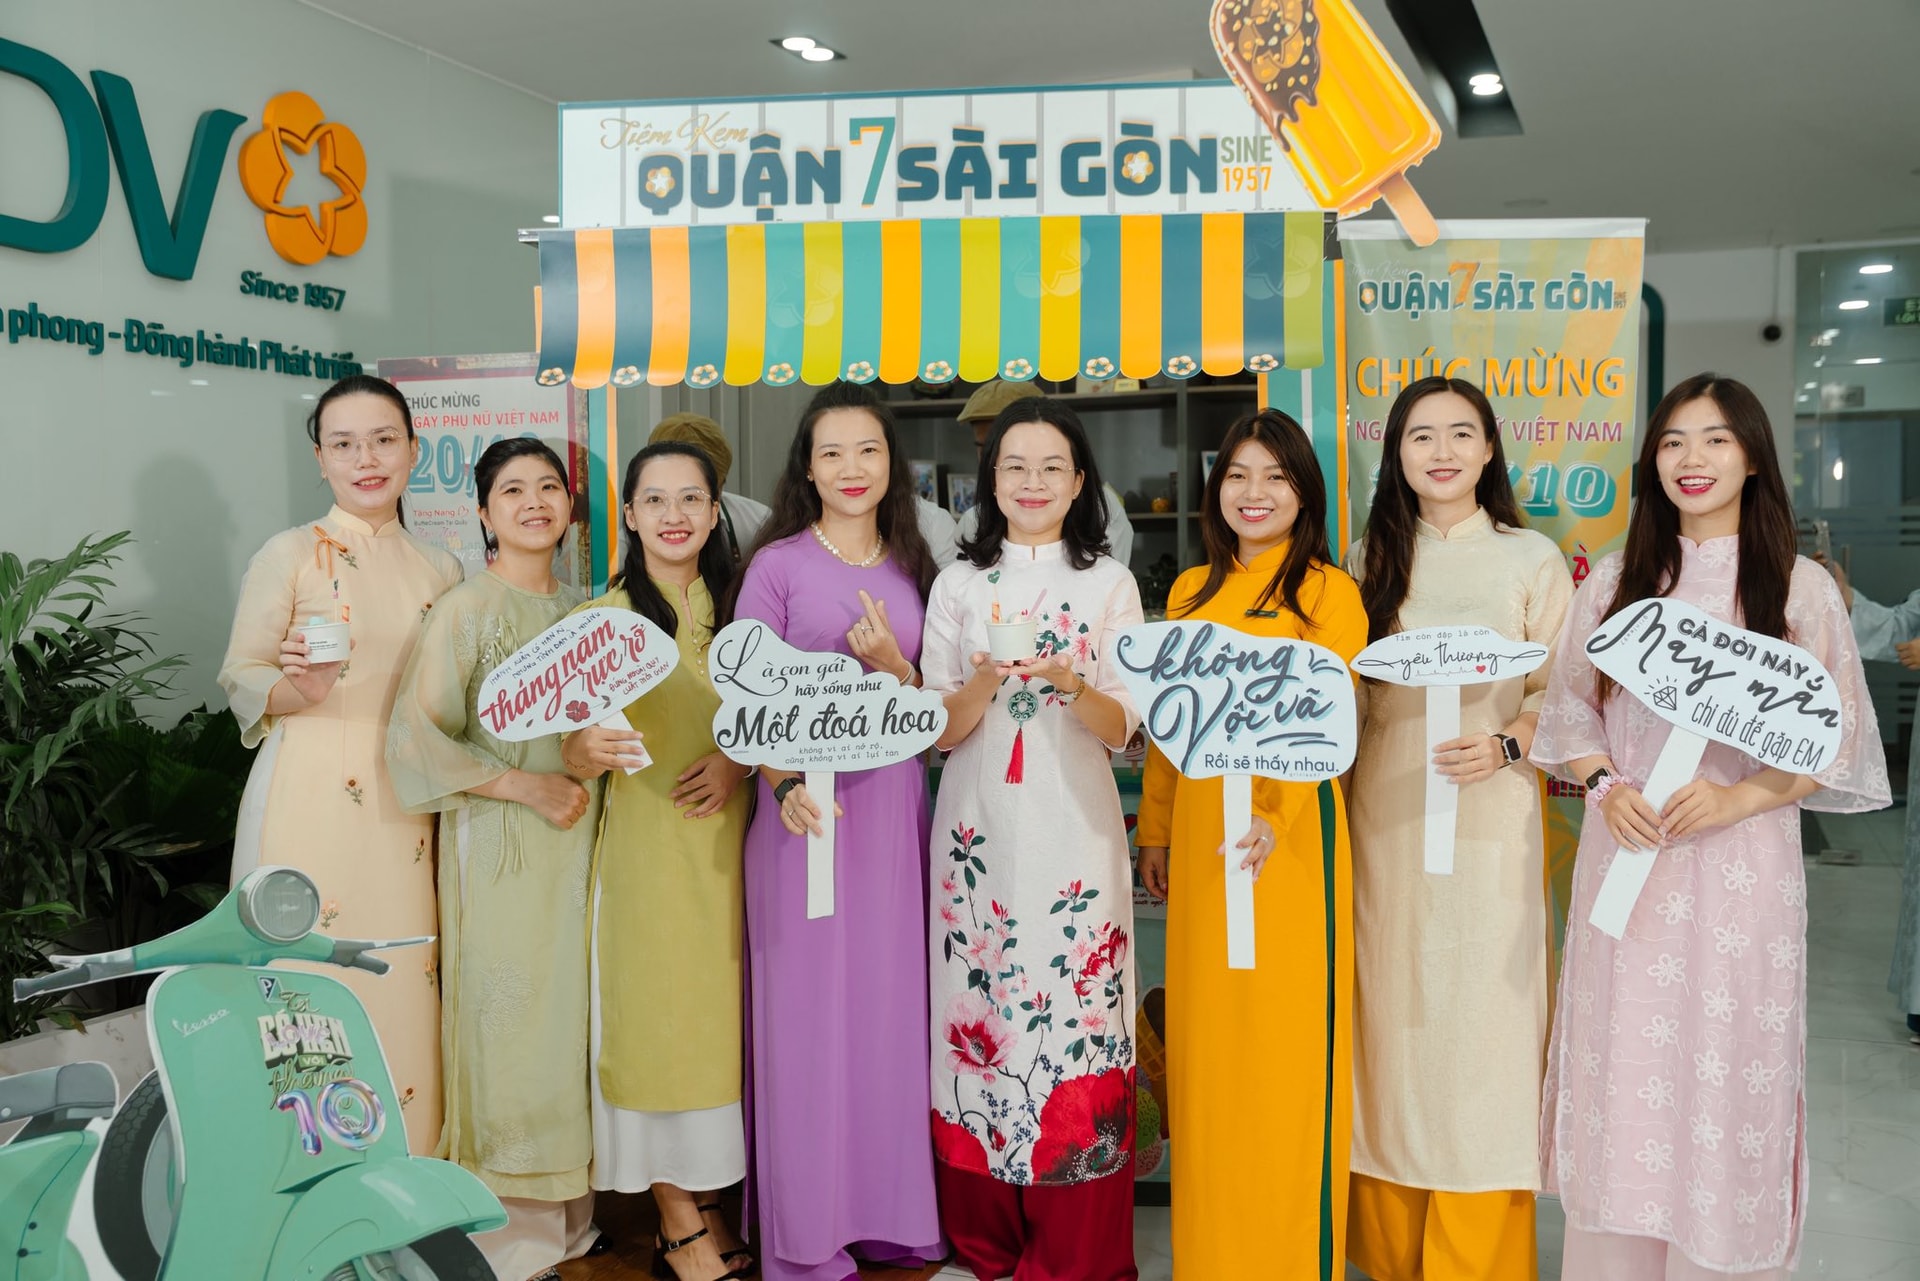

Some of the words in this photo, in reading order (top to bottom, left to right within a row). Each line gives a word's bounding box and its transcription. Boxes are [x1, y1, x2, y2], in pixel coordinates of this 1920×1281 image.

[677, 111, 749, 151] Kem
[1221, 136, 1272, 163] SINE
[639, 132, 842, 221] QUẬN
[849, 116, 896, 209] 7
[897, 124, 1037, 202] SÀI
[1060, 120, 1217, 197] GÒN
[1222, 166, 1272, 193] 1957
[240, 270, 299, 304] Since
[303, 282, 346, 312] 1957
[1359, 271, 1449, 320] QUẬN
[1448, 262, 1480, 309] 7
[1472, 271, 1535, 310] SÀI
[1544, 271, 1613, 310] GÒN
[9, 303, 104, 355] phong
[197, 329, 256, 369] hành
[260, 340, 312, 377] Phát
[1485, 347, 1625, 397] MỪNG
[406, 393, 438, 409] CHÚC
[442, 391, 480, 409] MỪNG
[412, 413, 437, 428] GÀY
[443, 415, 468, 430] PHỤ
[473, 411, 490, 426] NỮ
[496, 410, 524, 426] VIỆT
[530, 411, 559, 424] NAM
[1512, 416, 1559, 447] VIỆT
[1567, 422, 1622, 442] NAM
[479, 662, 577, 733] tháng
[562, 619, 616, 677] năm
[578, 648, 623, 697] rực
[620, 623, 646, 662] rỡ
[781, 664, 811, 676] con
[817, 657, 846, 681] gái
[1117, 623, 1299, 704] không
[1434, 641, 1515, 676] thương
[1586, 601, 1737, 696] May
[1747, 674, 1839, 728] mắn
[795, 684, 818, 698] hãy
[822, 680, 851, 696] sống
[856, 680, 881, 692] như
[1275, 687, 1334, 724] vã
[717, 704, 800, 750] Một
[809, 702, 870, 741] đoá
[881, 697, 938, 735] hoa
[1205, 754, 1228, 769] Rồi
[1234, 755, 1250, 769] sẽ
[1255, 754, 1290, 774] thấy
[1294, 757, 1339, 772] nhau.
[1758, 731, 1792, 764] gặp
[277, 1077, 387, 1156] 10
